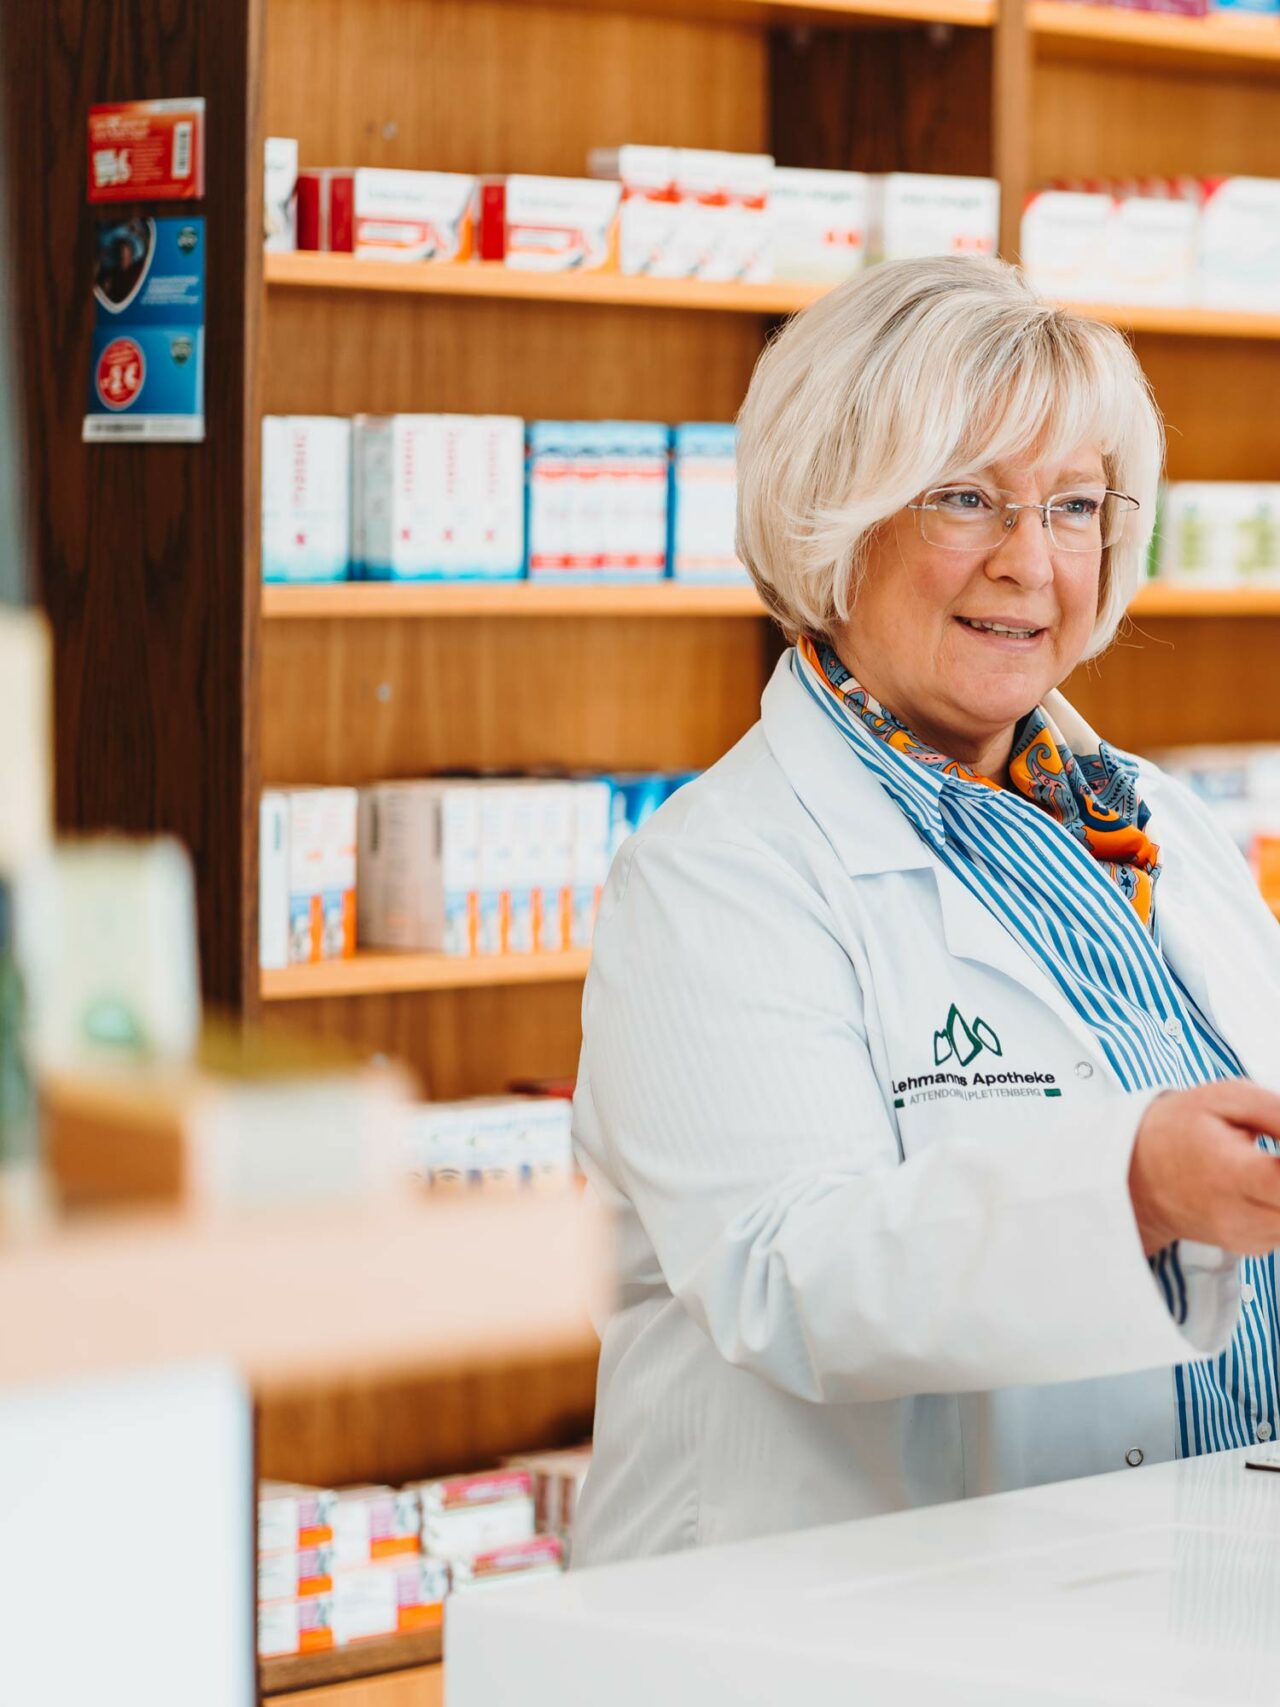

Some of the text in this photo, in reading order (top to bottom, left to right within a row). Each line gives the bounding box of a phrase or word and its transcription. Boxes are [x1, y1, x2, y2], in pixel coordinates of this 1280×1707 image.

[892, 1071, 1056, 1094] Lehmanns Apotheke
[967, 1088, 1042, 1101] PLETTENBERG
